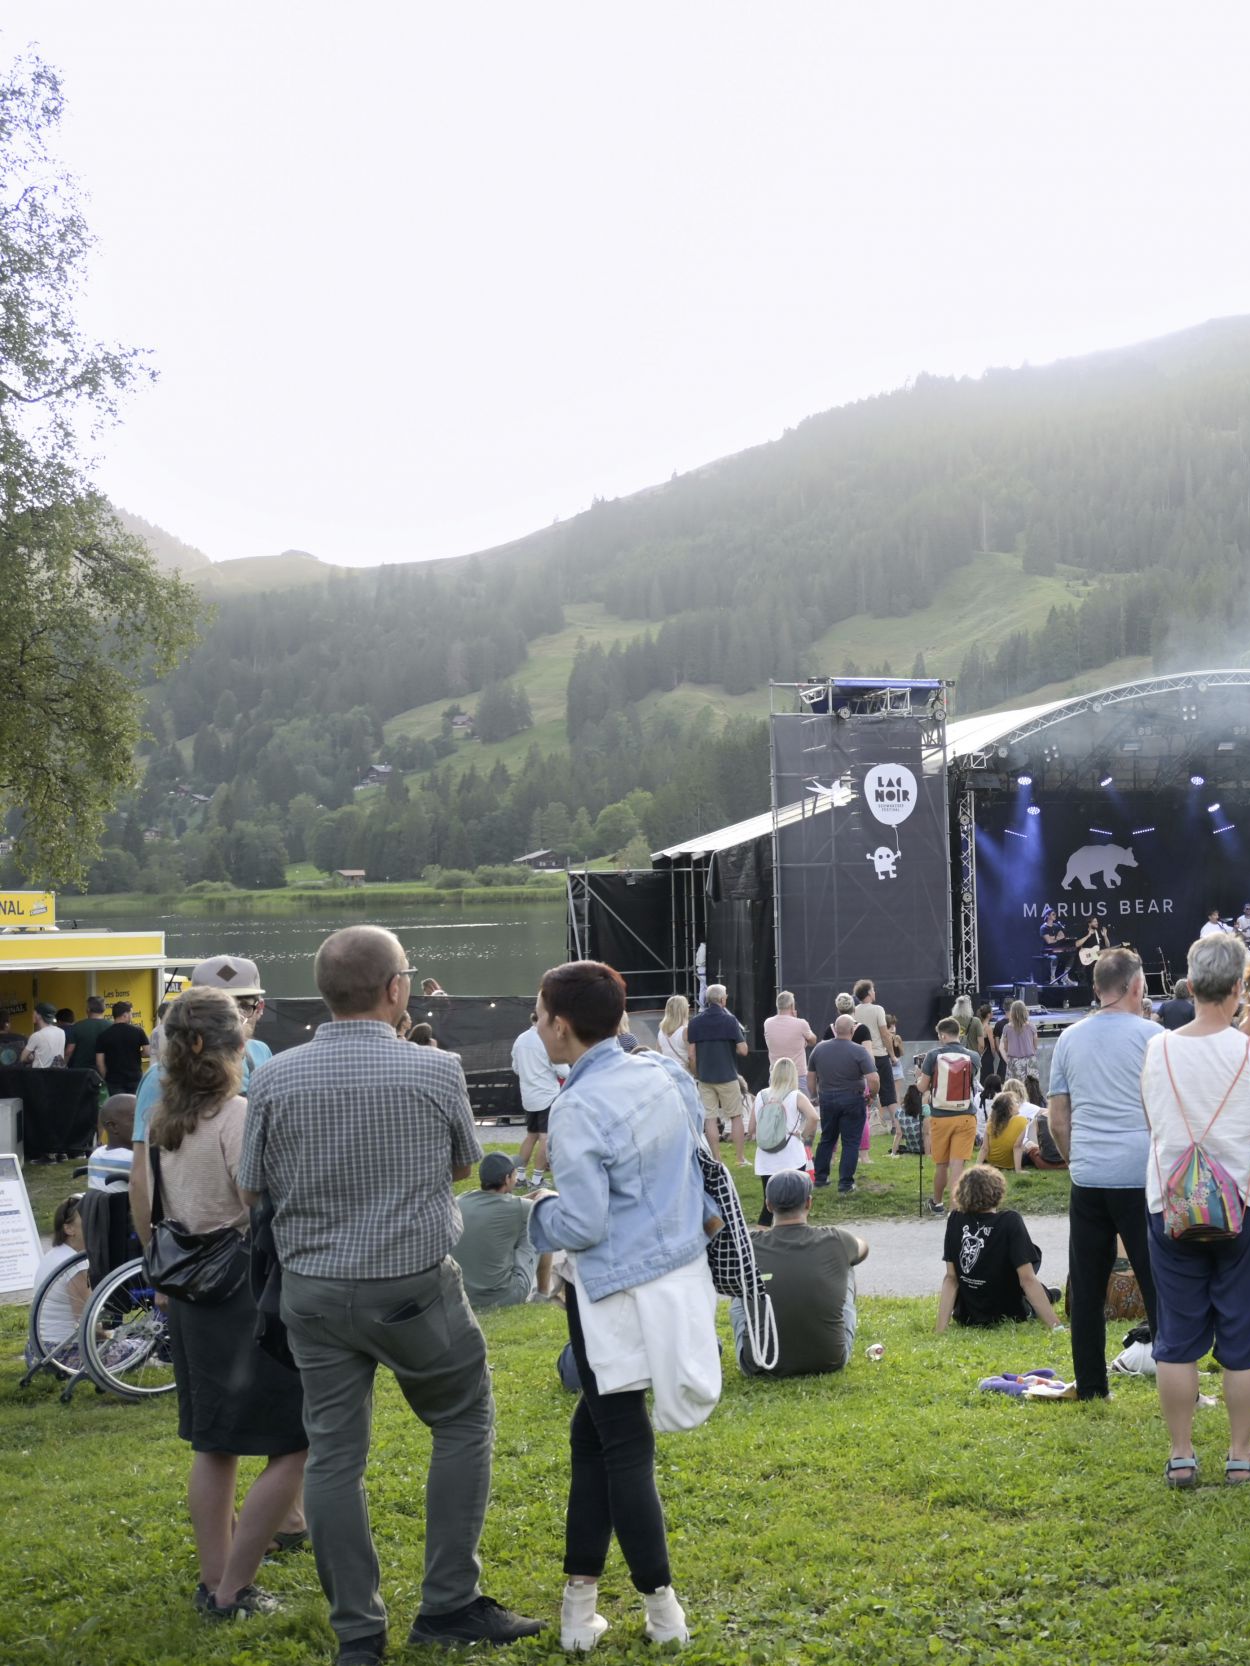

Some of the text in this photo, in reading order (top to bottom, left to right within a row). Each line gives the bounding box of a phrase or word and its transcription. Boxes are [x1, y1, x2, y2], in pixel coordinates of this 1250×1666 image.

[878, 776, 902, 788] LAC
[875, 789, 910, 802] NOIR
[1119, 898, 1174, 915] BEAR
